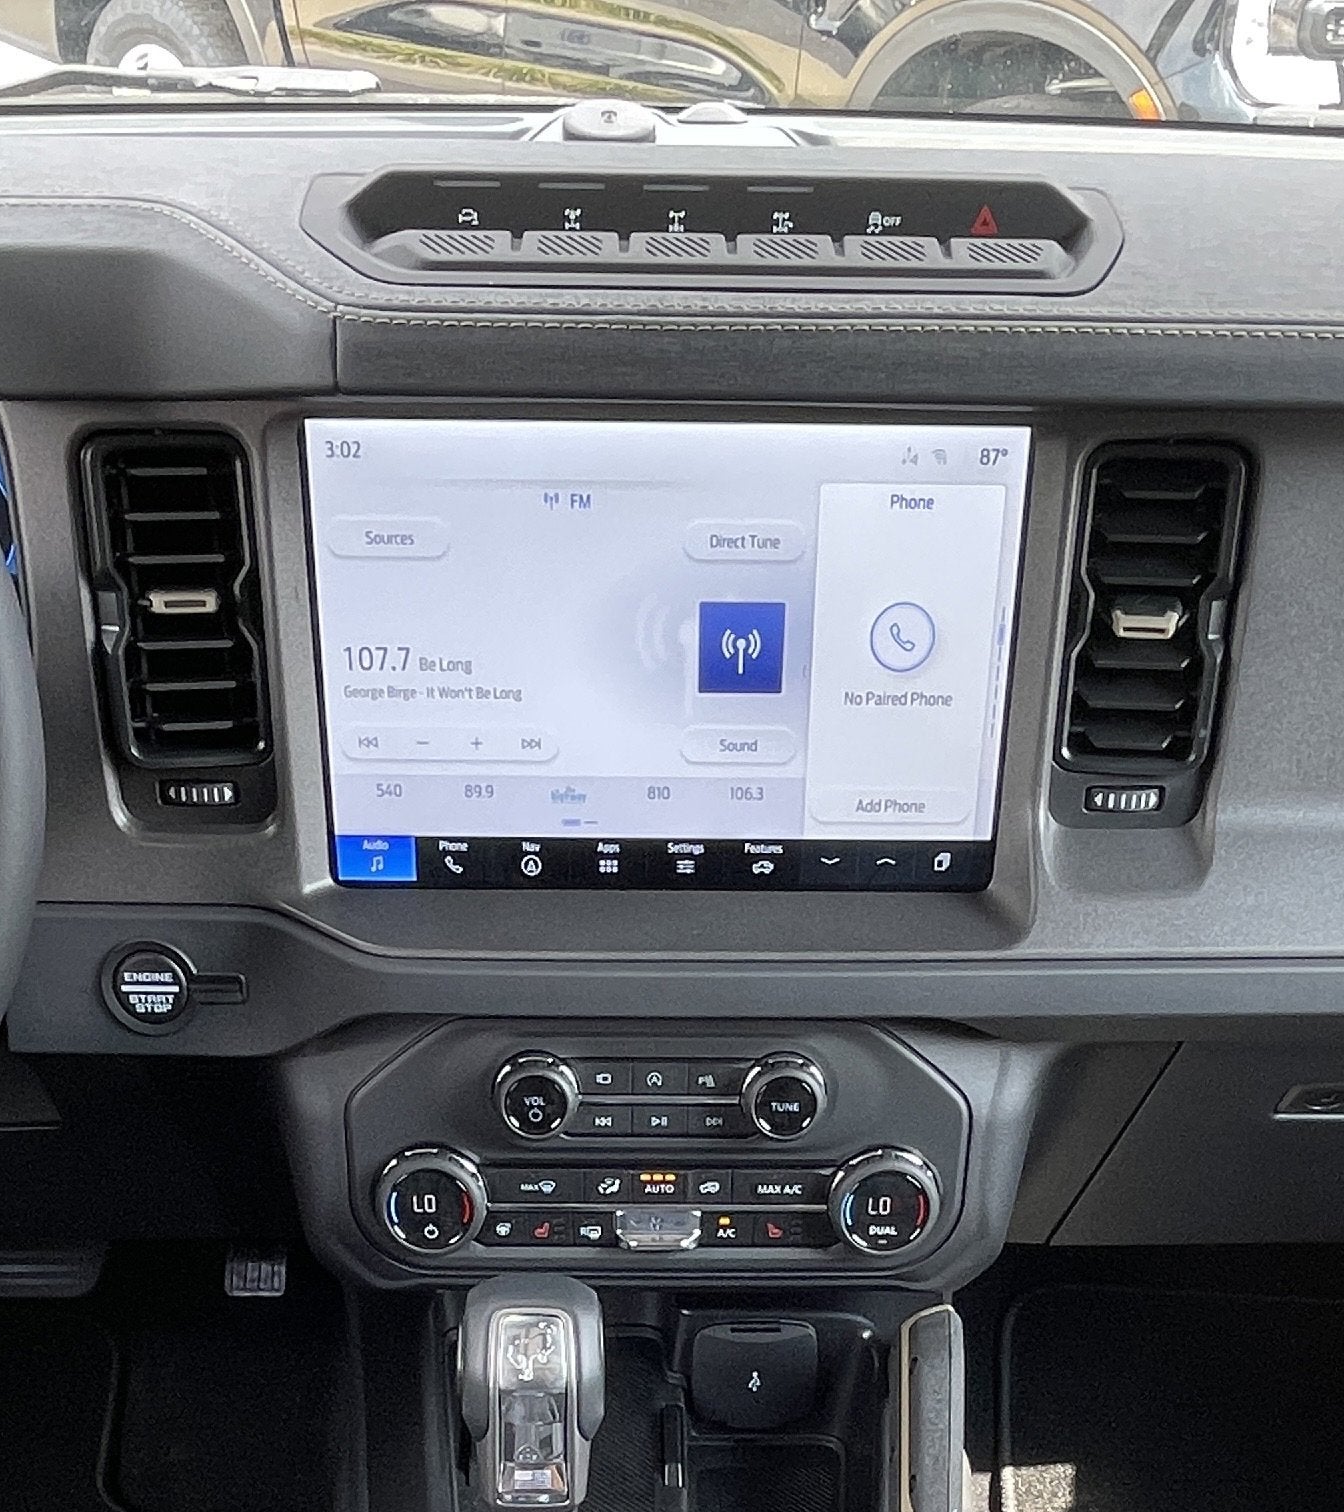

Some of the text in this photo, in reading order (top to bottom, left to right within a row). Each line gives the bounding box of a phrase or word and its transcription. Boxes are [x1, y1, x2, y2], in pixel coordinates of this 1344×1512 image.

[882, 216, 902, 227] OFF
[324, 440, 361, 458] 3:02
[570, 493, 591, 509] FM
[889, 493, 935, 510] Phone
[364, 530, 415, 546] Sources
[709, 534, 781, 549] Direct Tune
[343, 646, 473, 675] 107.7 Be Long
[343, 685, 385, 701] George
[387, 685, 417, 701] Birge
[426, 686, 435, 699] It
[437, 686, 474, 699] Won't
[476, 686, 491, 700] Be
[493, 686, 522, 702] Long
[843, 691, 953, 706] No Paired Phone
[719, 738, 758, 753] Sound
[376, 783, 402, 798] 540
[464, 784, 494, 799] 89.9
[647, 786, 671, 800] 810
[729, 786, 764, 801] 106.3
[855, 799, 926, 814] Add Phone
[362, 839, 389, 851] Audio
[438, 840, 468, 852] Phone
[522, 841, 541, 852] Nav
[597, 841, 620, 854] Apps
[667, 842, 705, 855] Settings
[744, 842, 784, 854] Features
[124, 971, 174, 982] ENGINE
[129, 994, 175, 1004] START
[136, 1003, 172, 1013] STOP
[523, 1096, 546, 1106] VOL
[770, 1102, 800, 1112] TUNE
[520, 1183, 539, 1191] MAX
[644, 1184, 675, 1194] AUTO
[757, 1184, 803, 1195] MAX A/C
[717, 1228, 736, 1239] A/C
[869, 1225, 898, 1236] DUAL
